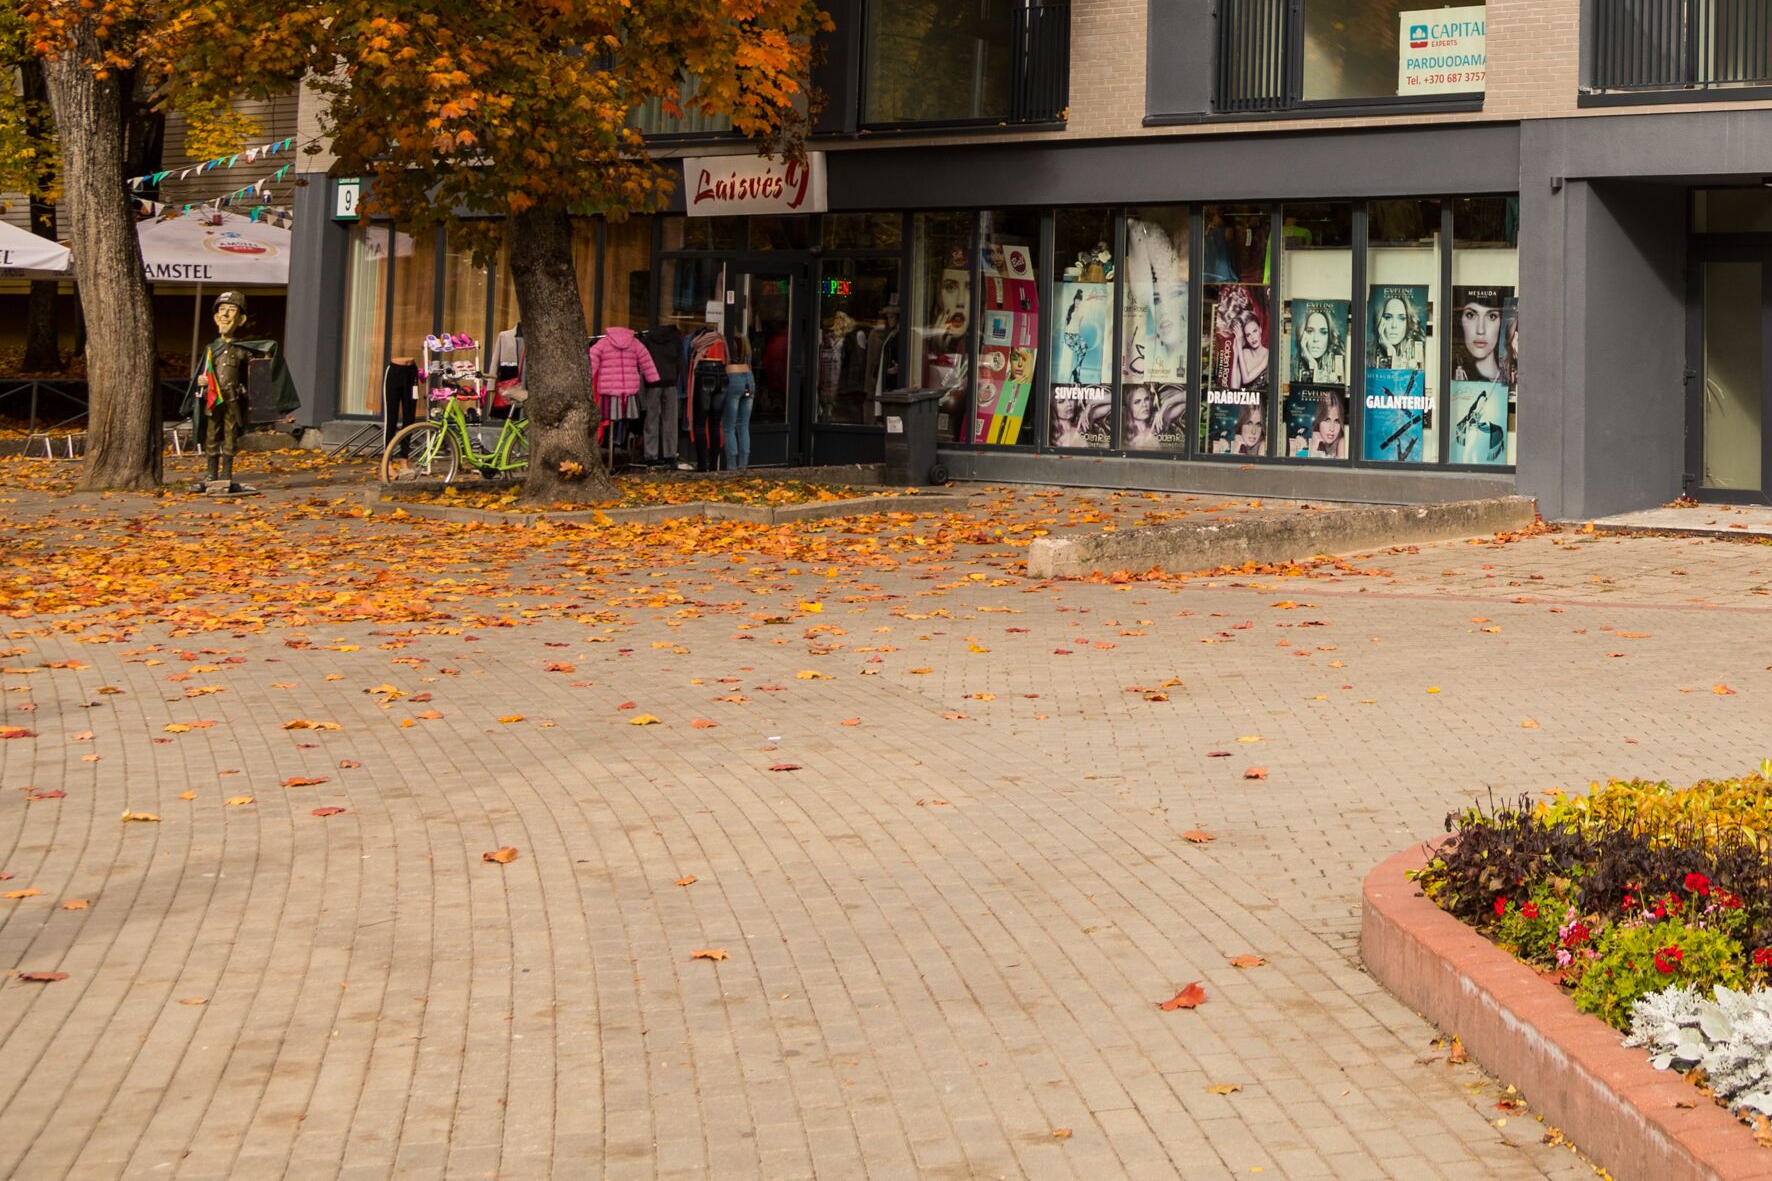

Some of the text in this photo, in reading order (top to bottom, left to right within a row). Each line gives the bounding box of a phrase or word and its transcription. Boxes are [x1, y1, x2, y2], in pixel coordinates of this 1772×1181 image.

[1431, 21, 1486, 39] CAPITAL
[1431, 39, 1457, 48] EXPERTS
[1406, 72, 1486, 85] Tel. +370 687 3757
[344, 189, 353, 212] 9
[144, 263, 213, 279] AMSTEL
[1054, 386, 1105, 400] SUVENYRAI
[1206, 387, 1260, 406] DRABUŽIAI
[1366, 394, 1437, 414] GALANTERIJA
